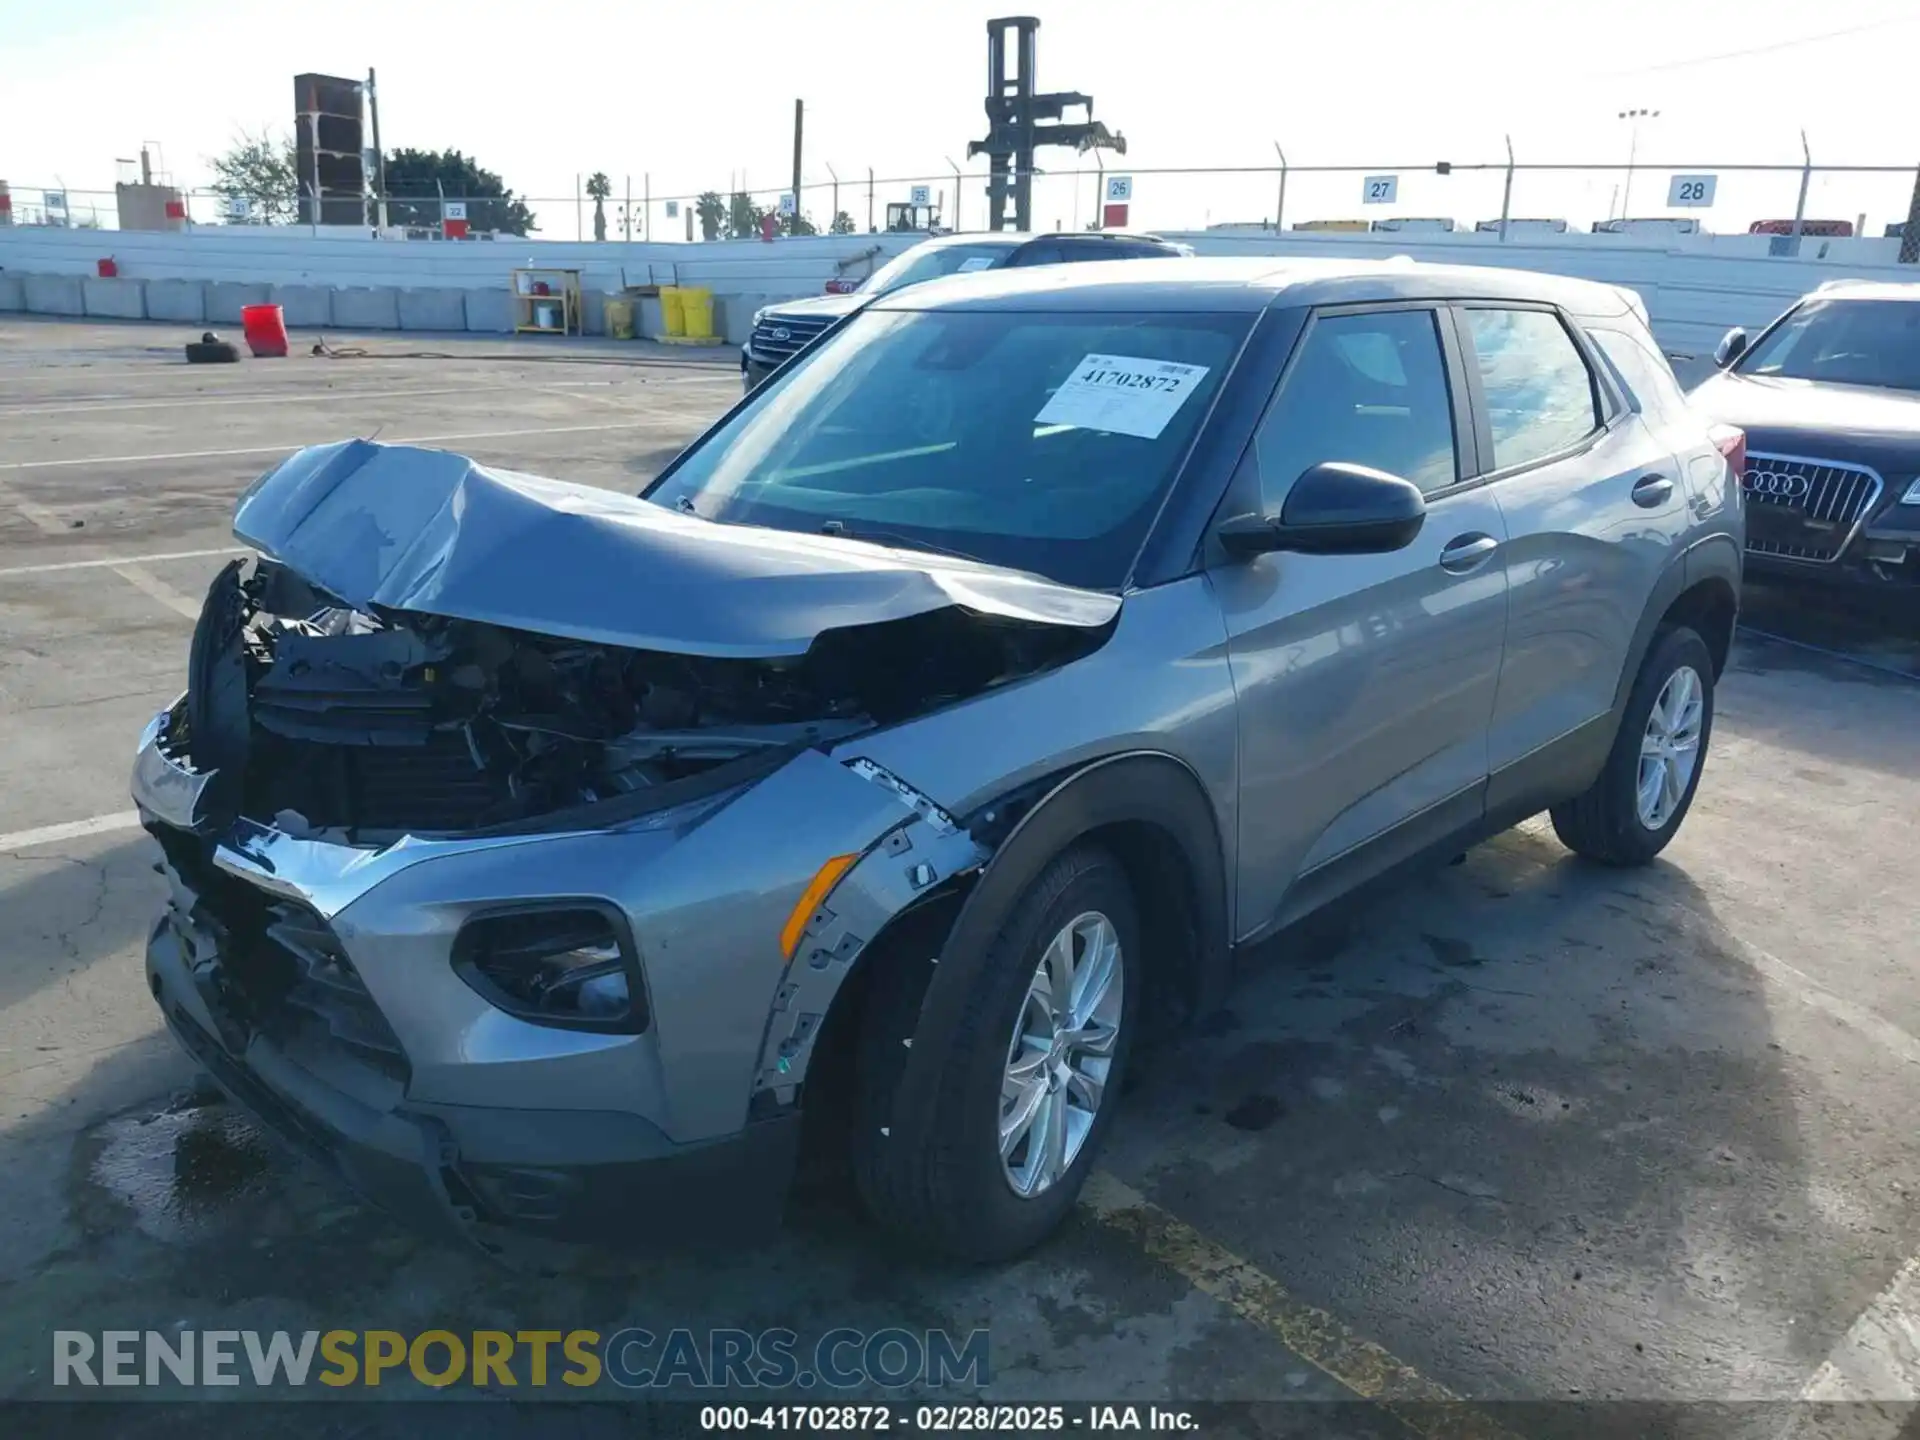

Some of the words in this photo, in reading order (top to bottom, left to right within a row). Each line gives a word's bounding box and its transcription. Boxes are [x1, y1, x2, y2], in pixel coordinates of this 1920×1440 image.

[1112, 182, 1127, 196] 26
[1371, 182, 1391, 198] 27
[1679, 182, 1705, 200] 28
[1082, 369, 1181, 392] 41702872
